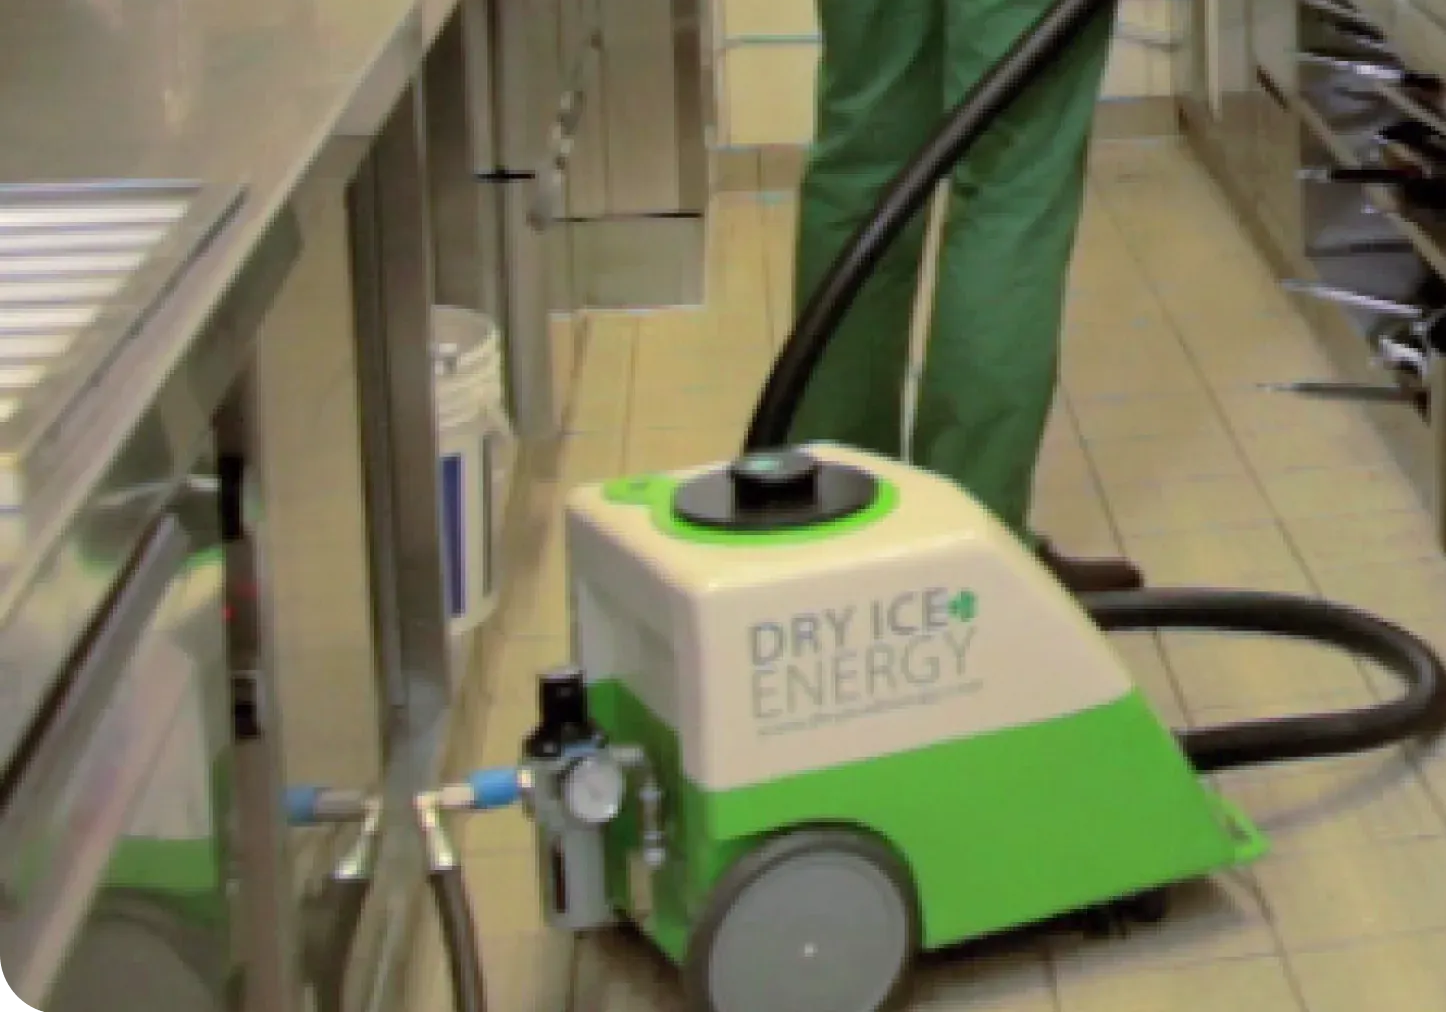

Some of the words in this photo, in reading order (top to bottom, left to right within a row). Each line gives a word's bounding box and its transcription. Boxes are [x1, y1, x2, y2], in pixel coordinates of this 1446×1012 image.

[748, 605, 857, 666] DRY
[869, 587, 948, 640] ICE
[751, 626, 977, 719] ENERGY
